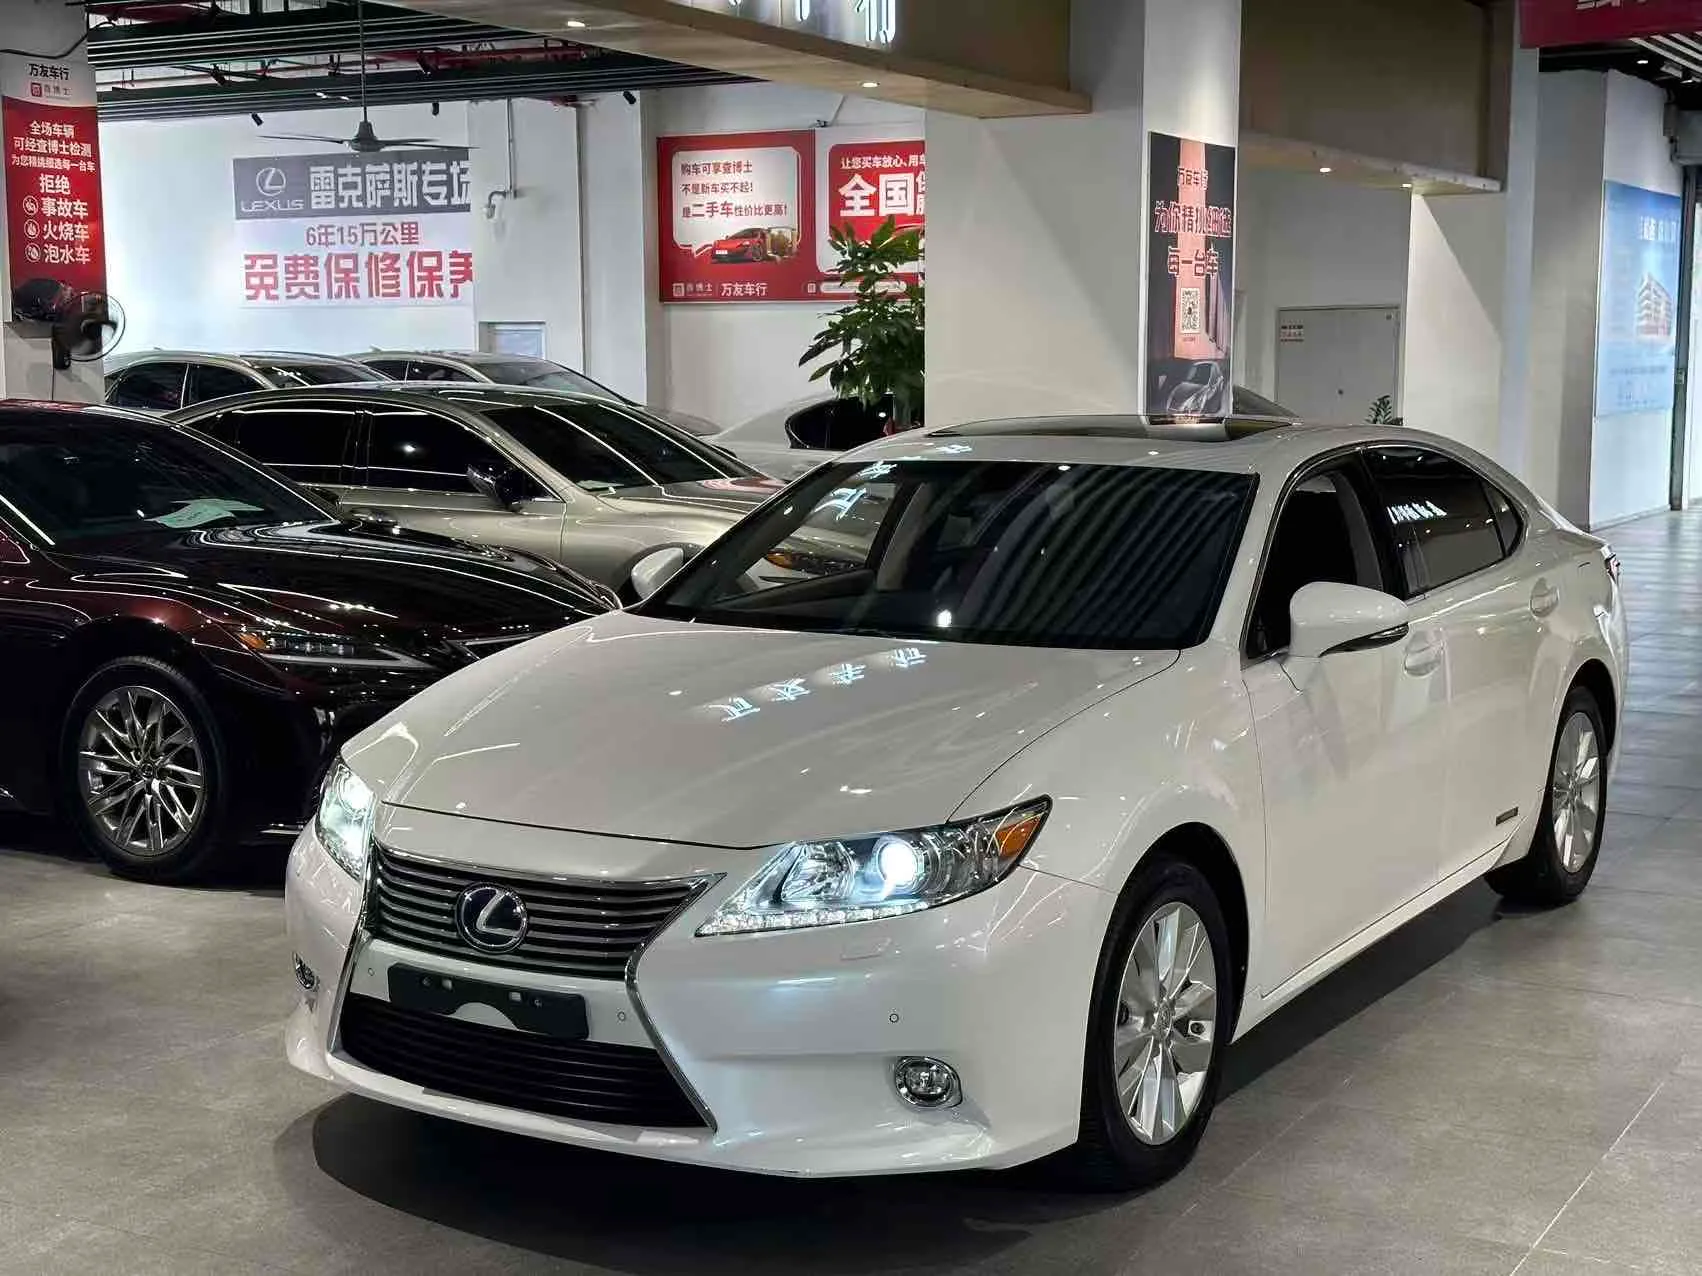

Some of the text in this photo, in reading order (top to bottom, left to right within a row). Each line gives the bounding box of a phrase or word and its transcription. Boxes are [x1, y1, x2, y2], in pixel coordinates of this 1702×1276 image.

[28, 63, 70, 80] 万友车行
[29, 120, 75, 138] 全场车辆
[13, 136, 92, 158] 可经查博士检测
[39, 173, 71, 195] 拒绝
[309, 160, 472, 209] 雷克萨斯专场
[838, 171, 926, 217] 全国
[41, 197, 89, 219] 事故车
[240, 200, 305, 213] LEXUS
[43, 220, 90, 241] 火烧车
[306, 221, 420, 247] 6年15万公里
[43, 243, 91, 265] 泡水车
[1167, 245, 1220, 279] 每一台车
[721, 281, 768, 297] 万友车行
